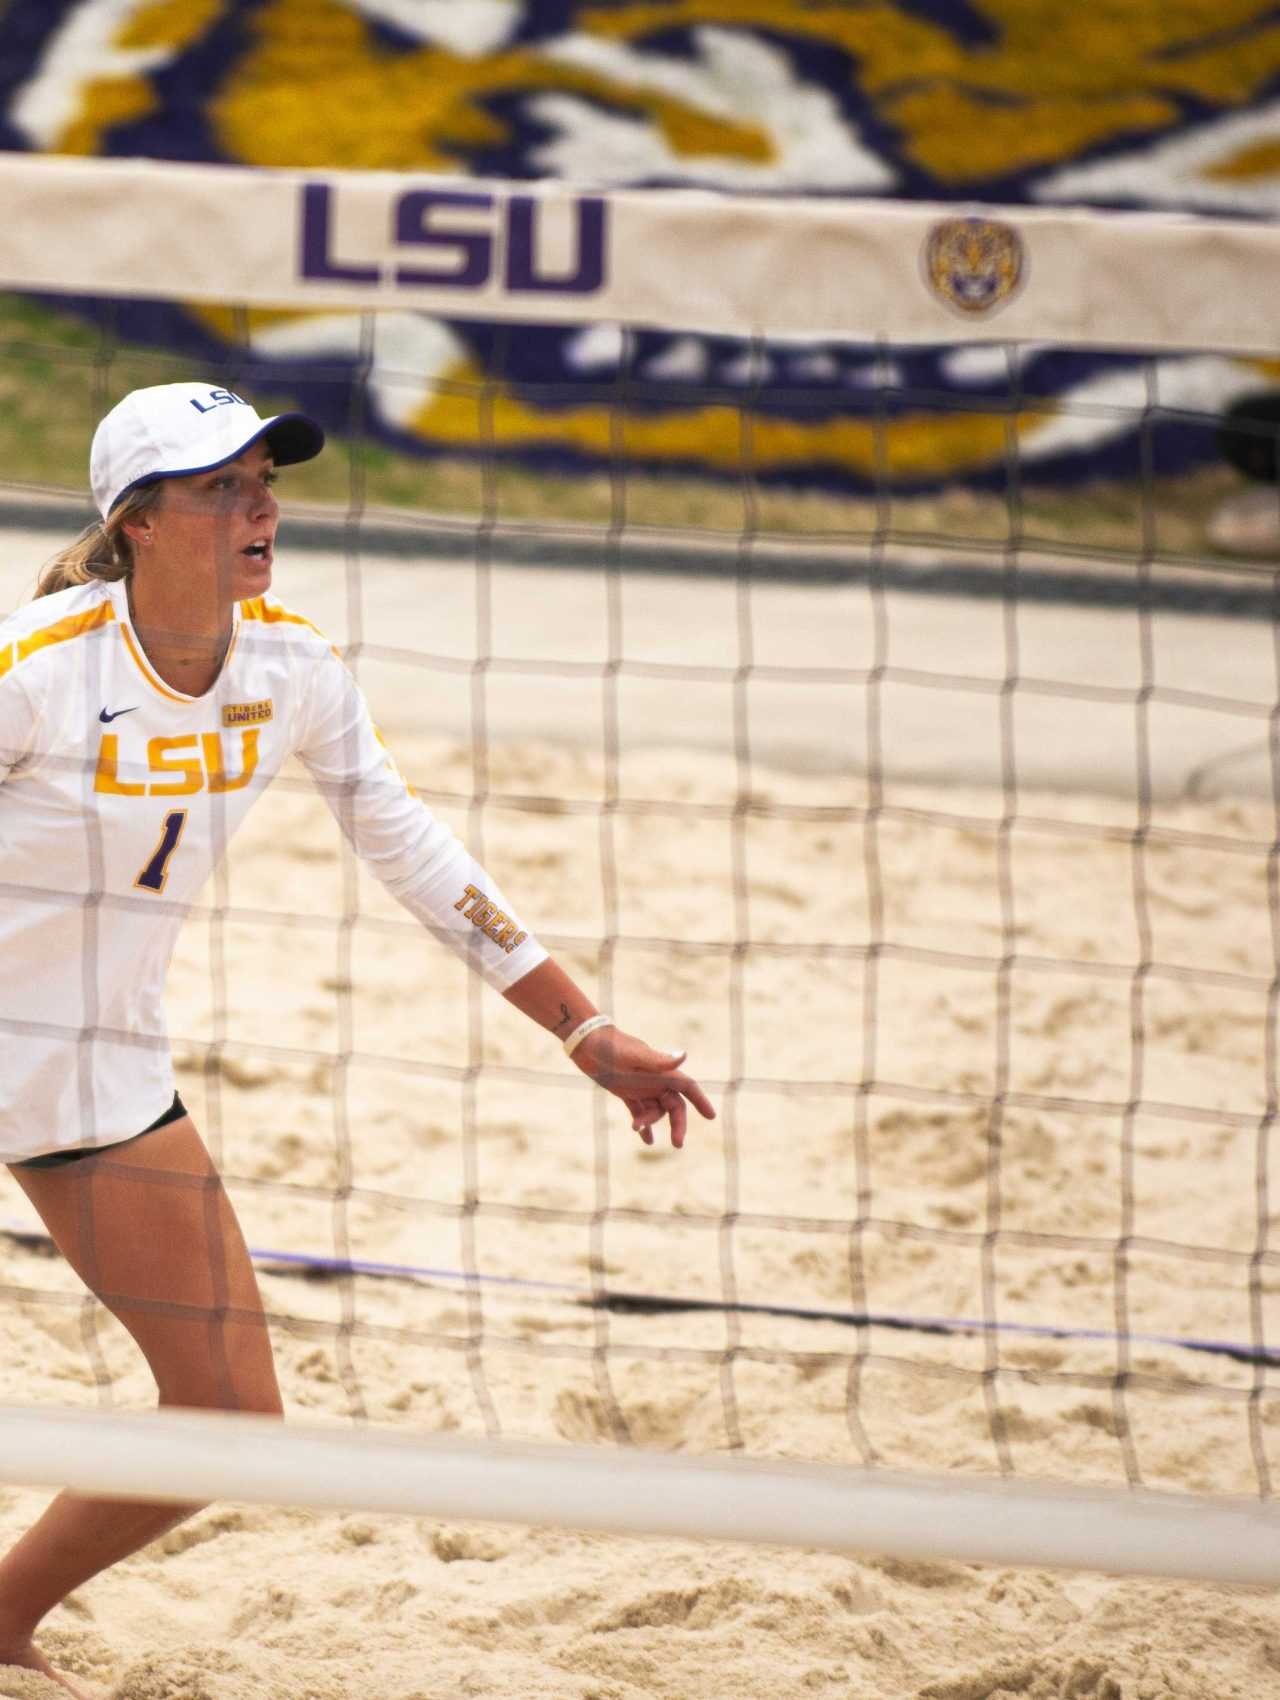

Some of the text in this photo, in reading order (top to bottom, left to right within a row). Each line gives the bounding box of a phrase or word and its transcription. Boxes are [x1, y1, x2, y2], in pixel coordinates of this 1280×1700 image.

[299, 182, 607, 296] LSU
[190, 390, 250, 413] LSU
[228, 708, 271, 721] UNITED
[94, 728, 260, 796] LSU
[133, 808, 189, 895] 1
[454, 883, 528, 954] TIGERS
